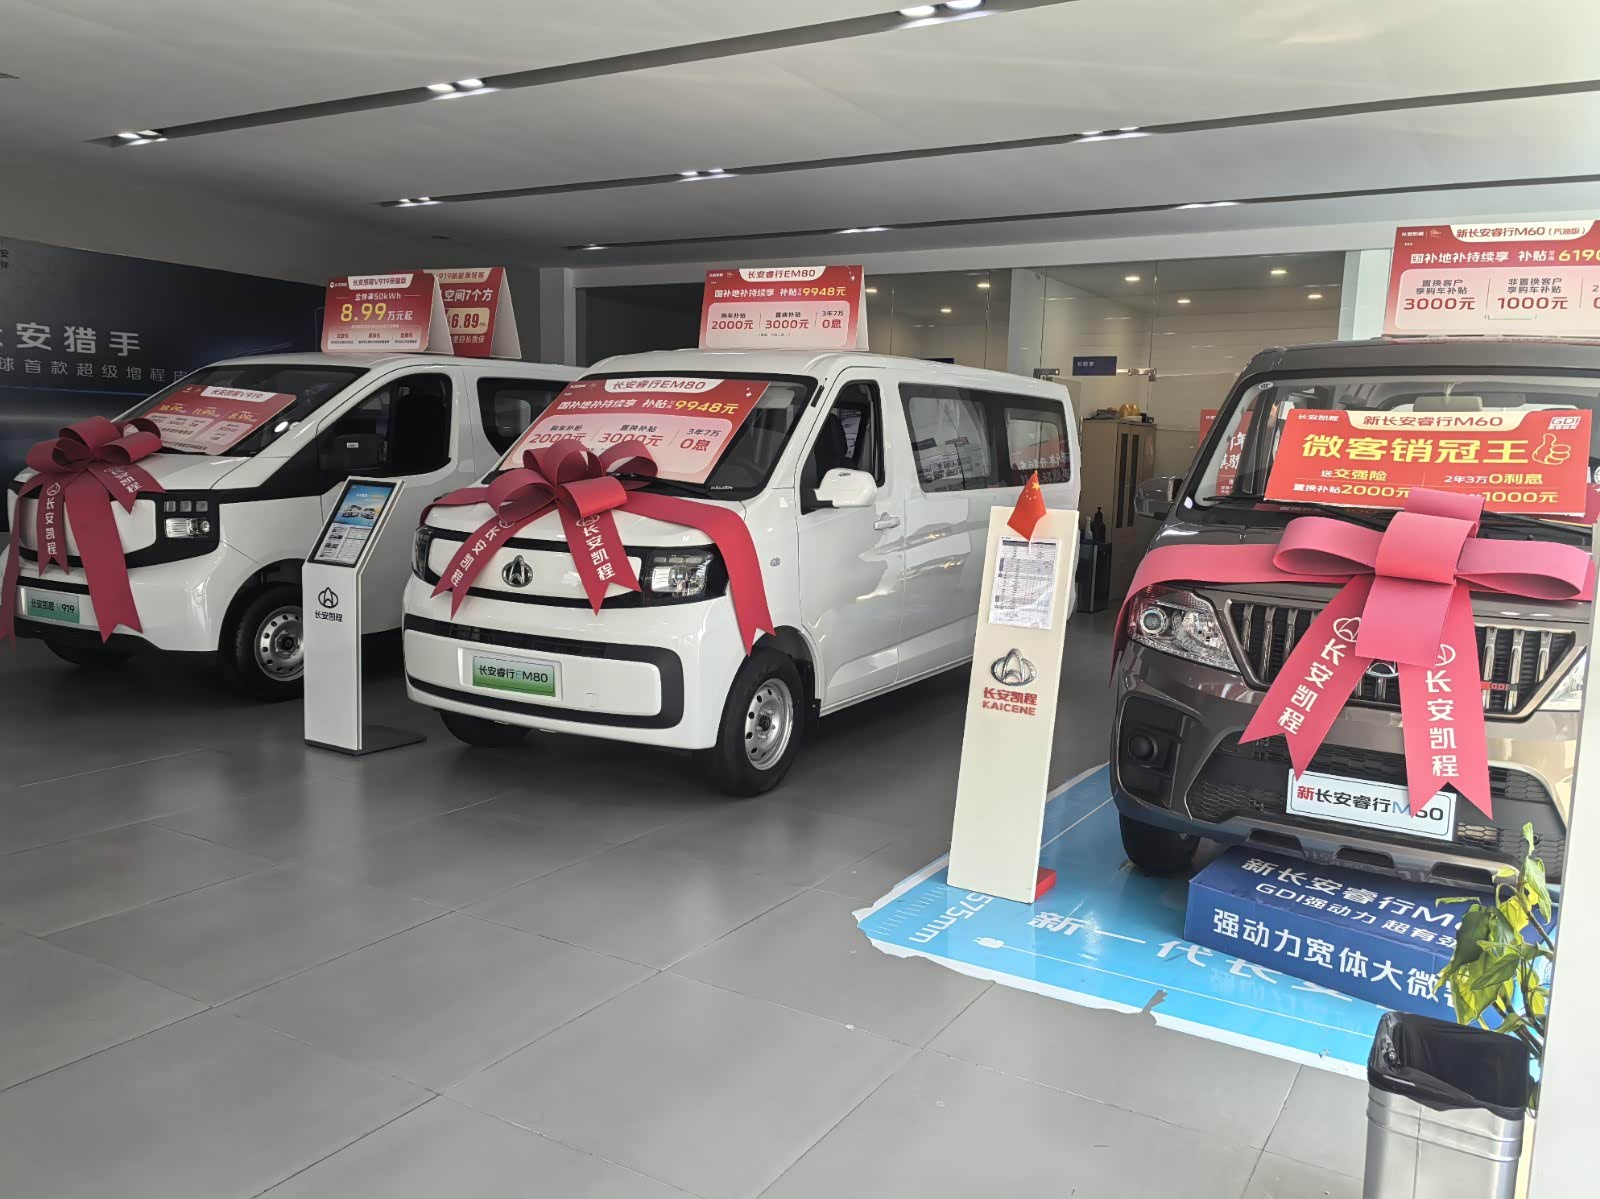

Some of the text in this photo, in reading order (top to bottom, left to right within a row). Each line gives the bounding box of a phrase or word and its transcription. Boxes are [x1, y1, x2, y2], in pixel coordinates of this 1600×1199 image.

[1410, 251, 1509, 264] 国补地补持续享
[444, 287, 494, 302] 空间7个方
[714, 288, 775, 298] 国补地补持续享
[1404, 297, 1476, 310] 3000元
[1497, 296, 1568, 309] 1000元
[340, 303, 414, 322] 8.99万元起
[711, 320, 754, 330] 2000元
[765, 319, 810, 329] 3000元
[822, 319, 842, 329] 0息
[0, 322, 141, 357] 安猎手
[556, 399, 638, 411] 国补地补持续享
[1363, 415, 1504, 427] 新长安睿行M60
[679, 438, 711, 451] 0息
[1302, 434, 1529, 465] 微客销冠王
[1320, 469, 1388, 482] 送交强险
[1443, 473, 1544, 486] 2年3万0利息
[582, 525, 616, 582] 长安凯程
[479, 665, 549, 684] 长安睿行EM80
[1276, 638, 1348, 735] 长安凯程
[983, 686, 1038, 706] 长安凯程
[982, 700, 1037, 716] KAICENE
[1425, 669, 1460, 777] 长安凯程
[1241, 857, 1464, 930] 新长安睿行M
[1255, 883, 1377, 925] GDI强动力
[1213, 908, 1456, 1009] 强动力宽体大微
